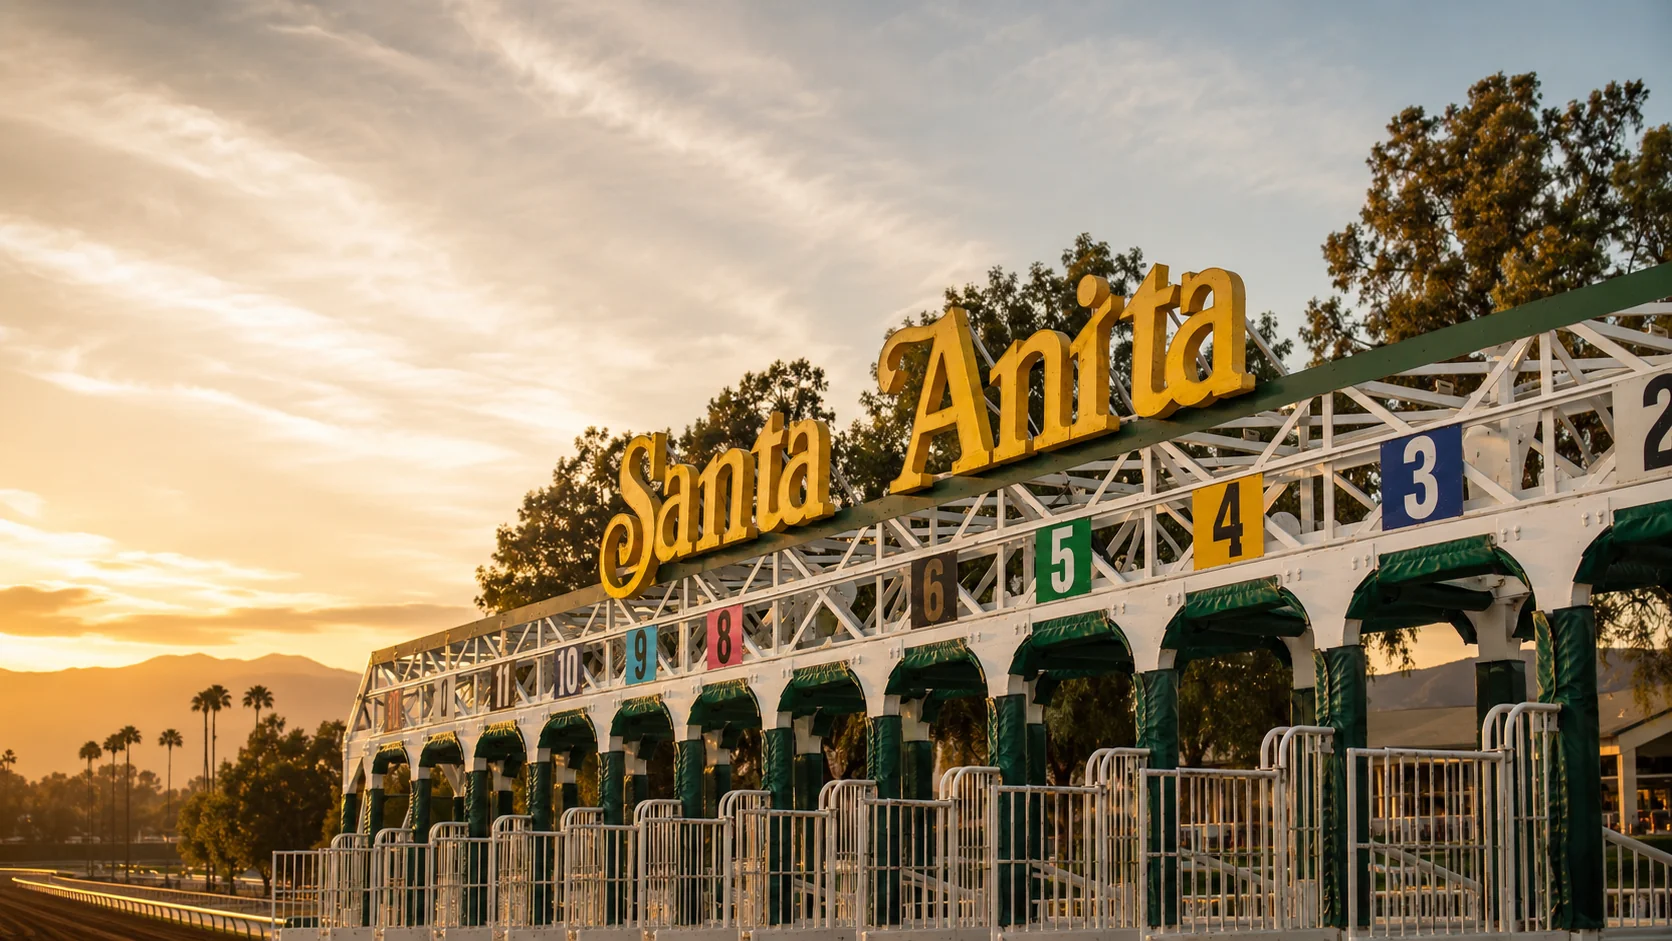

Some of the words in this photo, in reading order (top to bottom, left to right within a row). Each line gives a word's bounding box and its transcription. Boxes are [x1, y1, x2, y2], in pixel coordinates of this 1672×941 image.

[600, 411, 835, 600] Santa
[878, 262, 1255, 494] Anita
[1643, 373, 1672, 471] 2
[1403, 435, 1439, 520] 3
[1213, 481, 1243, 558] 4
[923, 558, 944, 622] 6
[1051, 525, 1075, 593] 5
[634, 629, 647, 680] 9
[717, 609, 731, 664] 8
[496, 663, 510, 708] 11
[558, 646, 578, 696] 10
